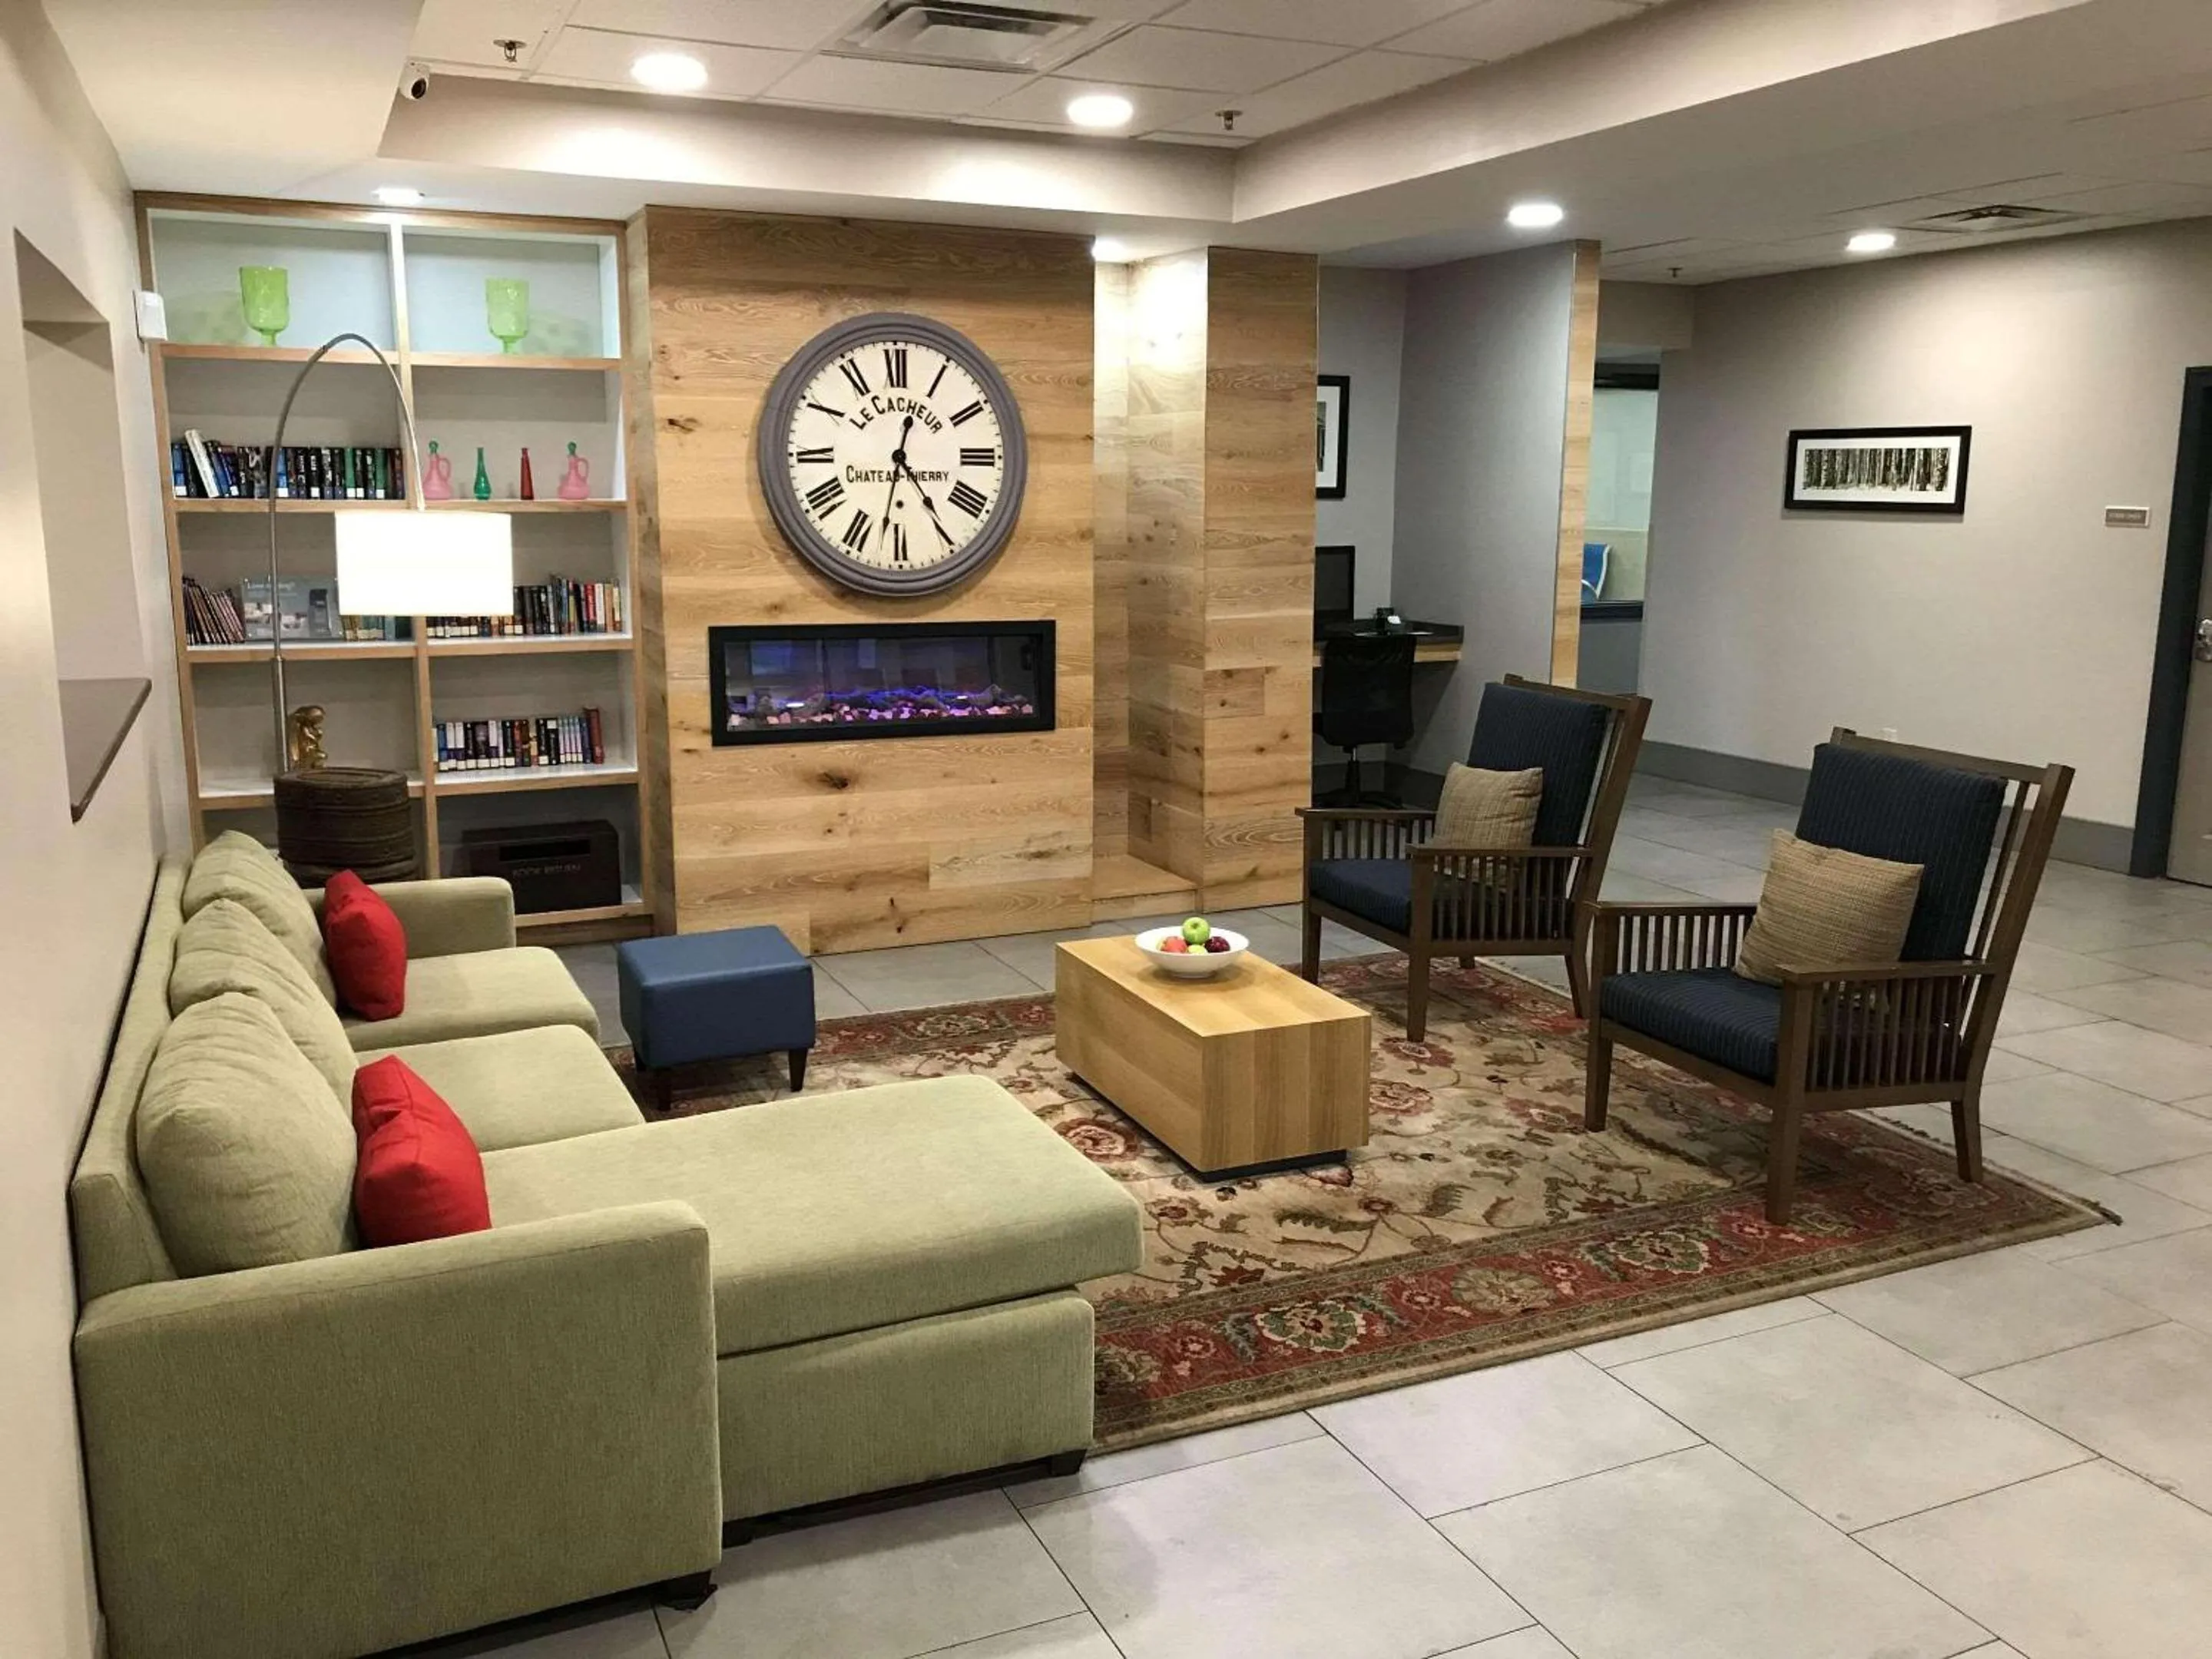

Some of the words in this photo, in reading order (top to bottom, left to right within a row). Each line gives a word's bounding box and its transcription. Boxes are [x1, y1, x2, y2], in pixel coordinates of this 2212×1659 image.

[883, 349, 908, 389] XII
[926, 364, 948, 398] I
[849, 407, 875, 430] LE
[871, 395, 943, 434] CACHEUR
[949, 400, 984, 427] II
[959, 448, 995, 467] III
[947, 480, 988, 519] IIII
